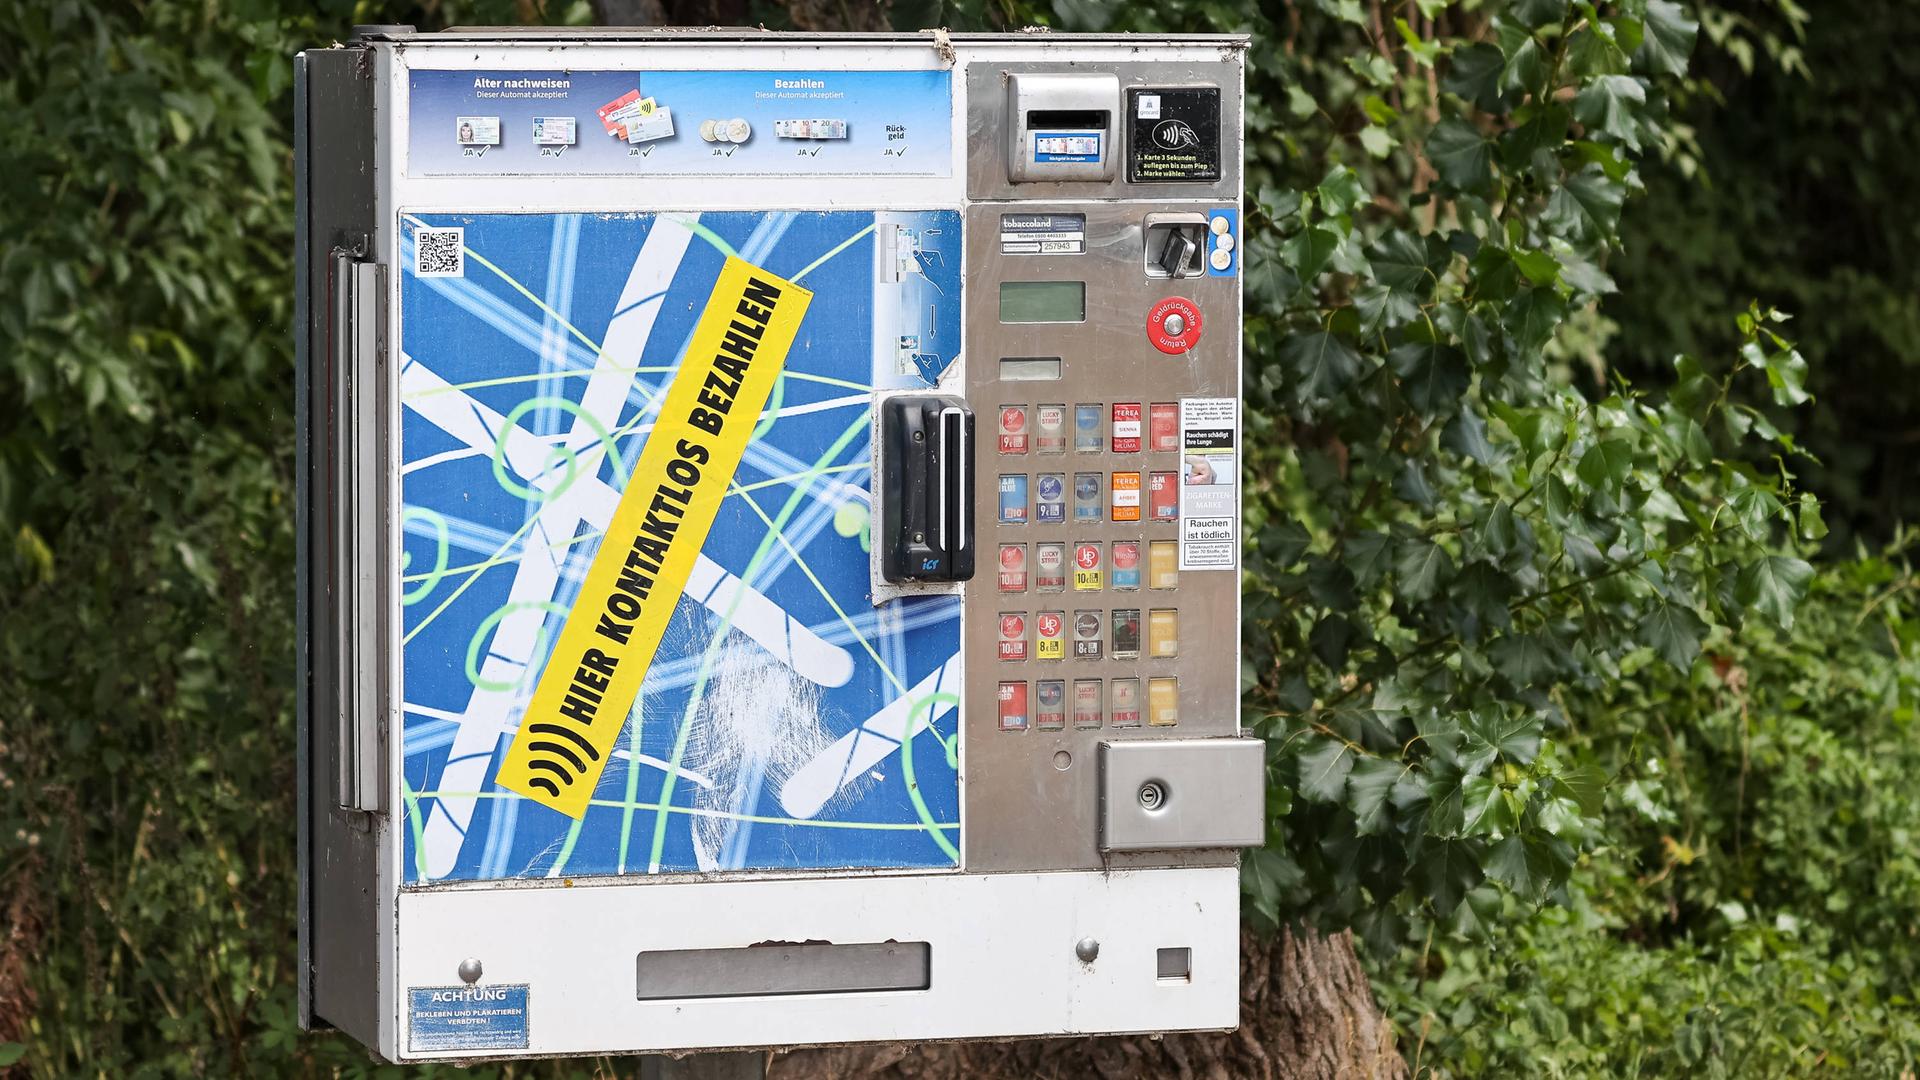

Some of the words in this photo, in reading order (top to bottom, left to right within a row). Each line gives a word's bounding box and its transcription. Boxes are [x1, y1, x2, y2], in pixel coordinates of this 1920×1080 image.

[474, 78, 502, 88] Alter
[504, 78, 570, 88] nachweisen
[774, 79, 825, 88] Bezahlen
[532, 90, 568, 100] akzeptiert
[809, 91, 844, 100] akzeptiert
[886, 124, 908, 134] Rück-
[888, 132, 905, 142] geld
[464, 149, 474, 157] JA
[541, 149, 552, 157] JA
[629, 148, 640, 156] JA
[712, 149, 723, 157] JA
[797, 149, 808, 157] JA
[884, 149, 894, 157] JA
[1143, 162, 1170, 170] auflegen
[1195, 162, 1208, 170] Piep
[1003, 218, 1051, 228] tobaccoland
[1044, 242, 1071, 250] 257943
[1152, 302, 1196, 327] Geldrückgabe
[1159, 336, 1187, 348] Return
[1208, 431, 1229, 439] schädigt
[1197, 439, 1212, 447] Lunge
[559, 648, 620, 726] HIER
[595, 438, 710, 646] KONTAKTLOS
[687, 276, 782, 436] BEZAHLEN
[1190, 519, 1228, 528] Rauchen
[1188, 531, 1198, 539] ist
[1201, 530, 1231, 539] tödlich
[431, 989, 507, 1002] ACHTUNG
[416, 1010, 452, 1018] BEKLEBEN
[473, 1008, 522, 1017] PLAKATIEREN
